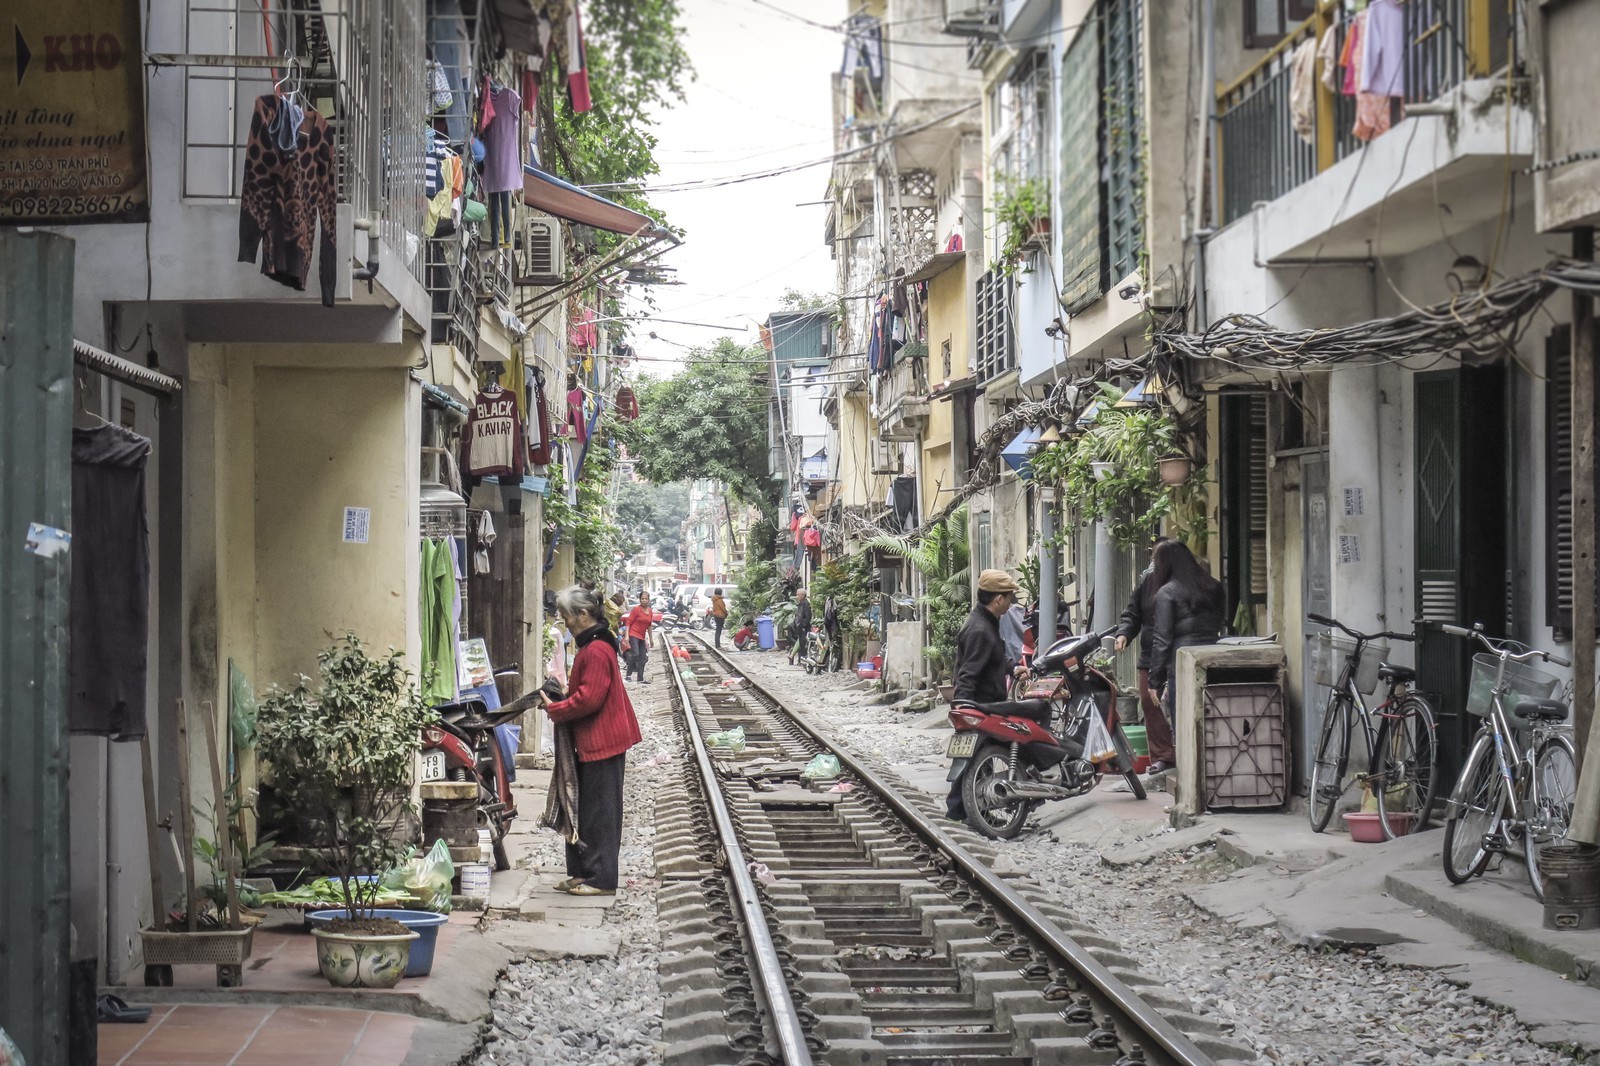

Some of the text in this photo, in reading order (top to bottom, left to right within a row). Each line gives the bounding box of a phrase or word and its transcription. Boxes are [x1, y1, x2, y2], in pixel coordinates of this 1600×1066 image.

[43, 33, 121, 73] KHO
[47, 159, 54, 170] 3
[36, 177, 49, 188] 20
[12, 196, 135, 216] 0982256676
[477, 401, 513, 419] BLACK
[478, 421, 511, 437] KAVIAR
